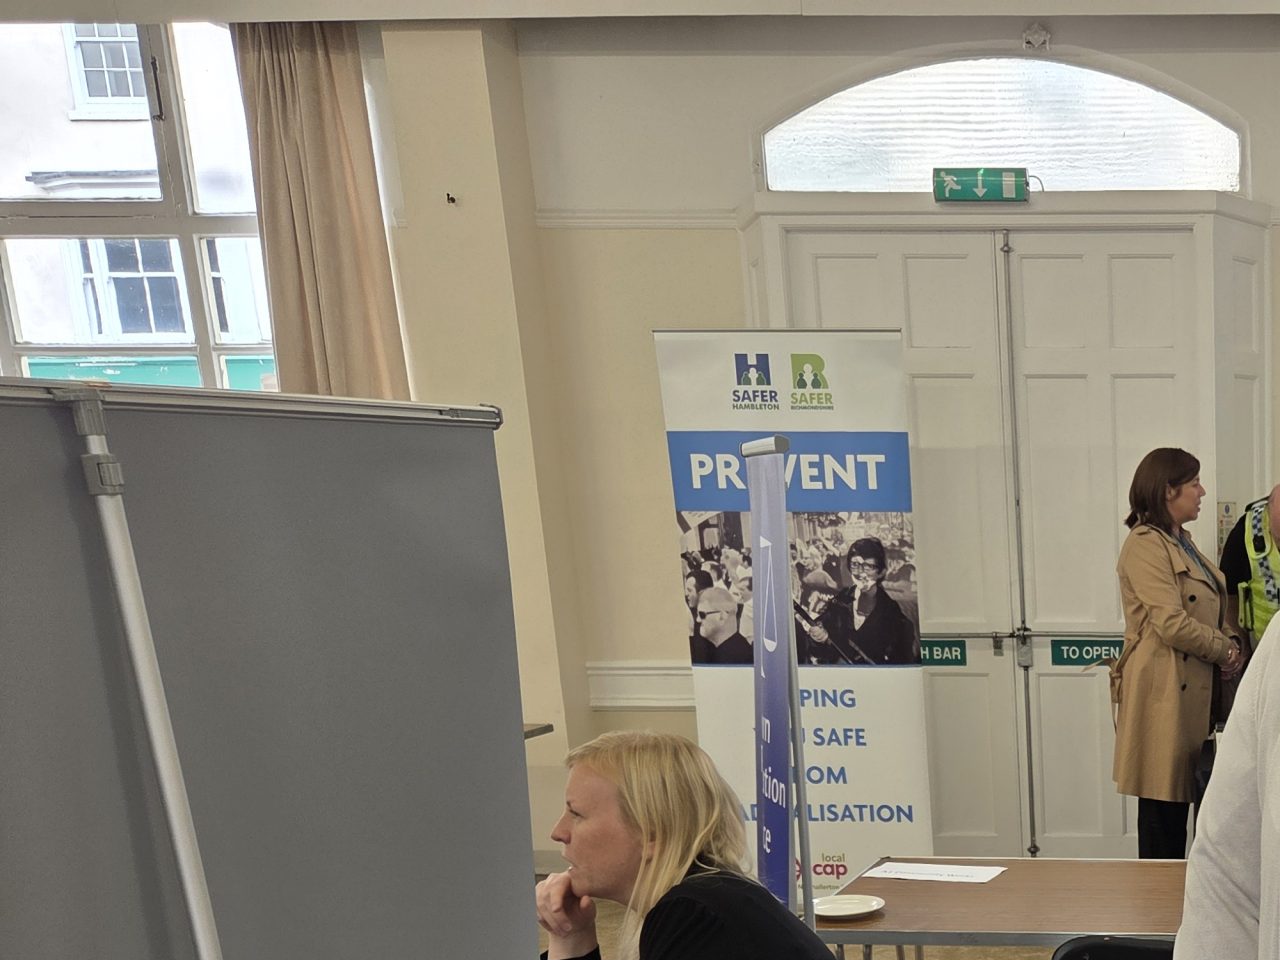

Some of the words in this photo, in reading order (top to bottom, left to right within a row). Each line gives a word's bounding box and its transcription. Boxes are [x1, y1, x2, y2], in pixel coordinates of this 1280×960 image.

[733, 390, 778, 402] SAFER
[790, 392, 833, 405] SAFER
[732, 403, 780, 411] HAMBLETON
[690, 453, 886, 490] PRVENT
[932, 646, 961, 661] BAR
[1061, 645, 1080, 661] TO
[1082, 645, 1119, 661] OPEN
[799, 689, 856, 708] PING
[813, 728, 867, 746] SAFE
[822, 853, 845, 863] local
[812, 863, 847, 879] cap
